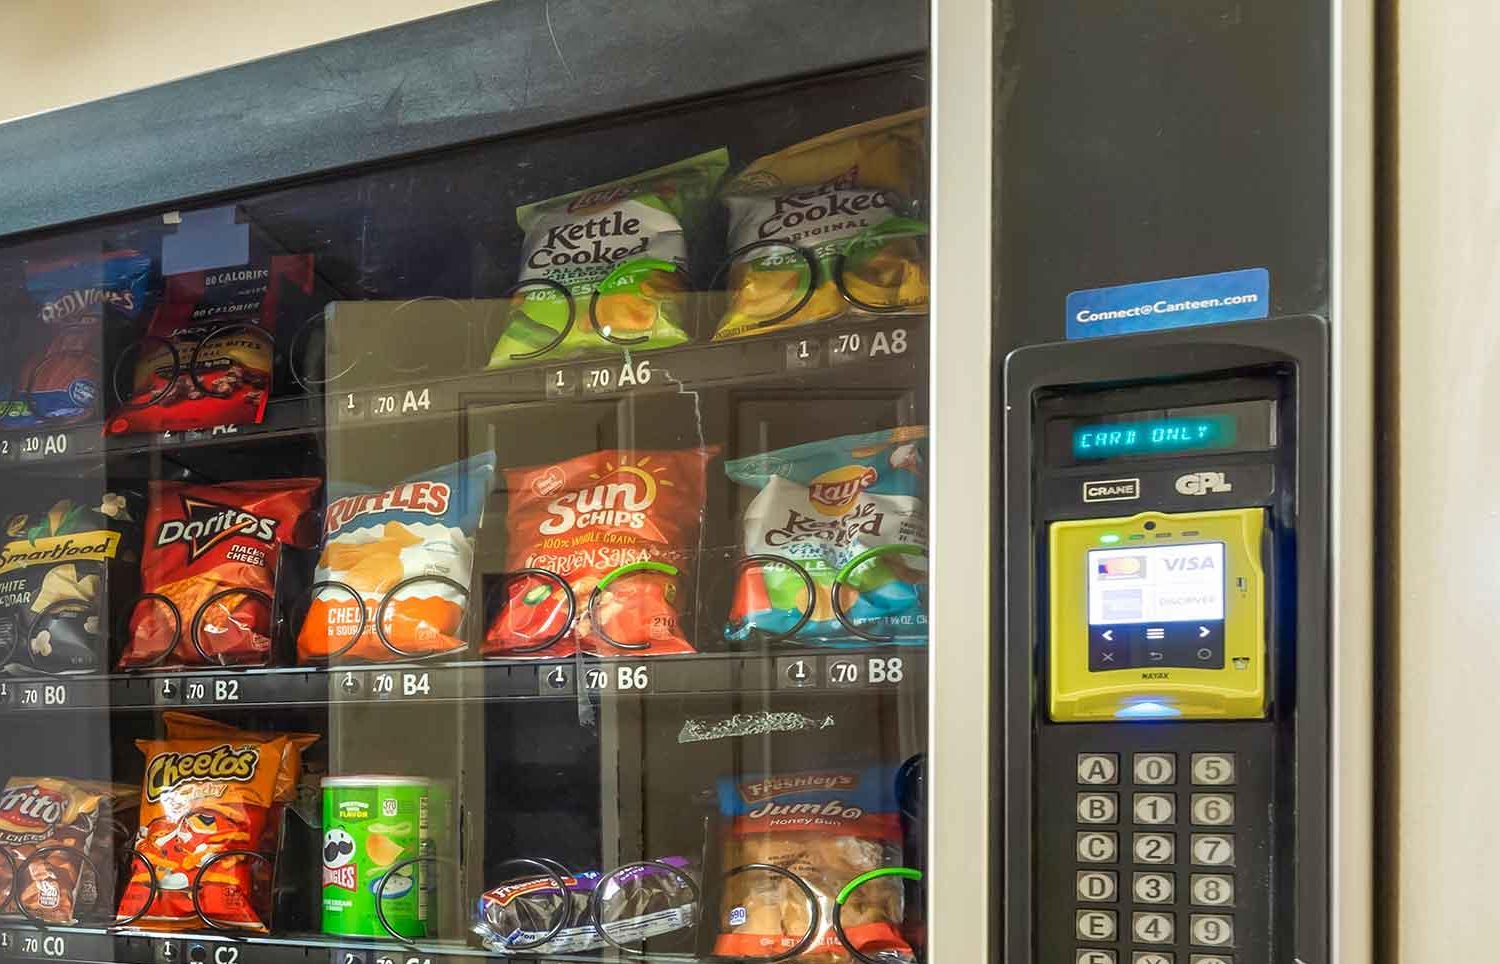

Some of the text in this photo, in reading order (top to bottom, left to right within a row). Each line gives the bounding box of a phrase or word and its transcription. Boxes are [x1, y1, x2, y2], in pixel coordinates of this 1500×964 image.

[543, 211, 640, 250] Kettle
[528, 237, 650, 270] Cooked
[1076, 293, 1258, 323] Connect@Canteen.com
[870, 329, 908, 357] A8
[618, 361, 651, 387] A6
[402, 389, 430, 413] A4
[44, 434, 67, 455] A0
[1080, 424, 1209, 448] CARD ONLY
[1087, 484, 1135, 497] CRANE
[1175, 471, 1232, 496] GPL
[539, 479, 657, 535] Sun
[158, 509, 277, 546] Doritos
[576, 510, 647, 530] CHIPS
[1164, 556, 1215, 572] VISA
[618, 666, 648, 690] B6
[868, 657, 904, 684] B8
[45, 685, 66, 704] B0
[215, 680, 239, 700] B2
[403, 673, 430, 696] B4
[148, 745, 255, 796] Cheetos
[1088, 761, 1106, 780] A
[1146, 761, 1162, 780] 0
[1204, 760, 1221, 779] 5
[750, 799, 863, 819] Jumbo
[1088, 800, 1105, 819] B
[1147, 800, 1158, 819] 1
[1203, 799, 1221, 821] 6
[1088, 837, 1105, 857] C
[1145, 839, 1162, 859] 2
[1204, 840, 1221, 861] 7
[1088, 877, 1106, 896] D
[1145, 878, 1161, 898] 3
[1204, 881, 1221, 901] 8
[1089, 915, 1104, 936] E
[1143, 918, 1162, 938] 4
[1204, 921, 1220, 941] 9
[44, 936, 65, 956] C0
